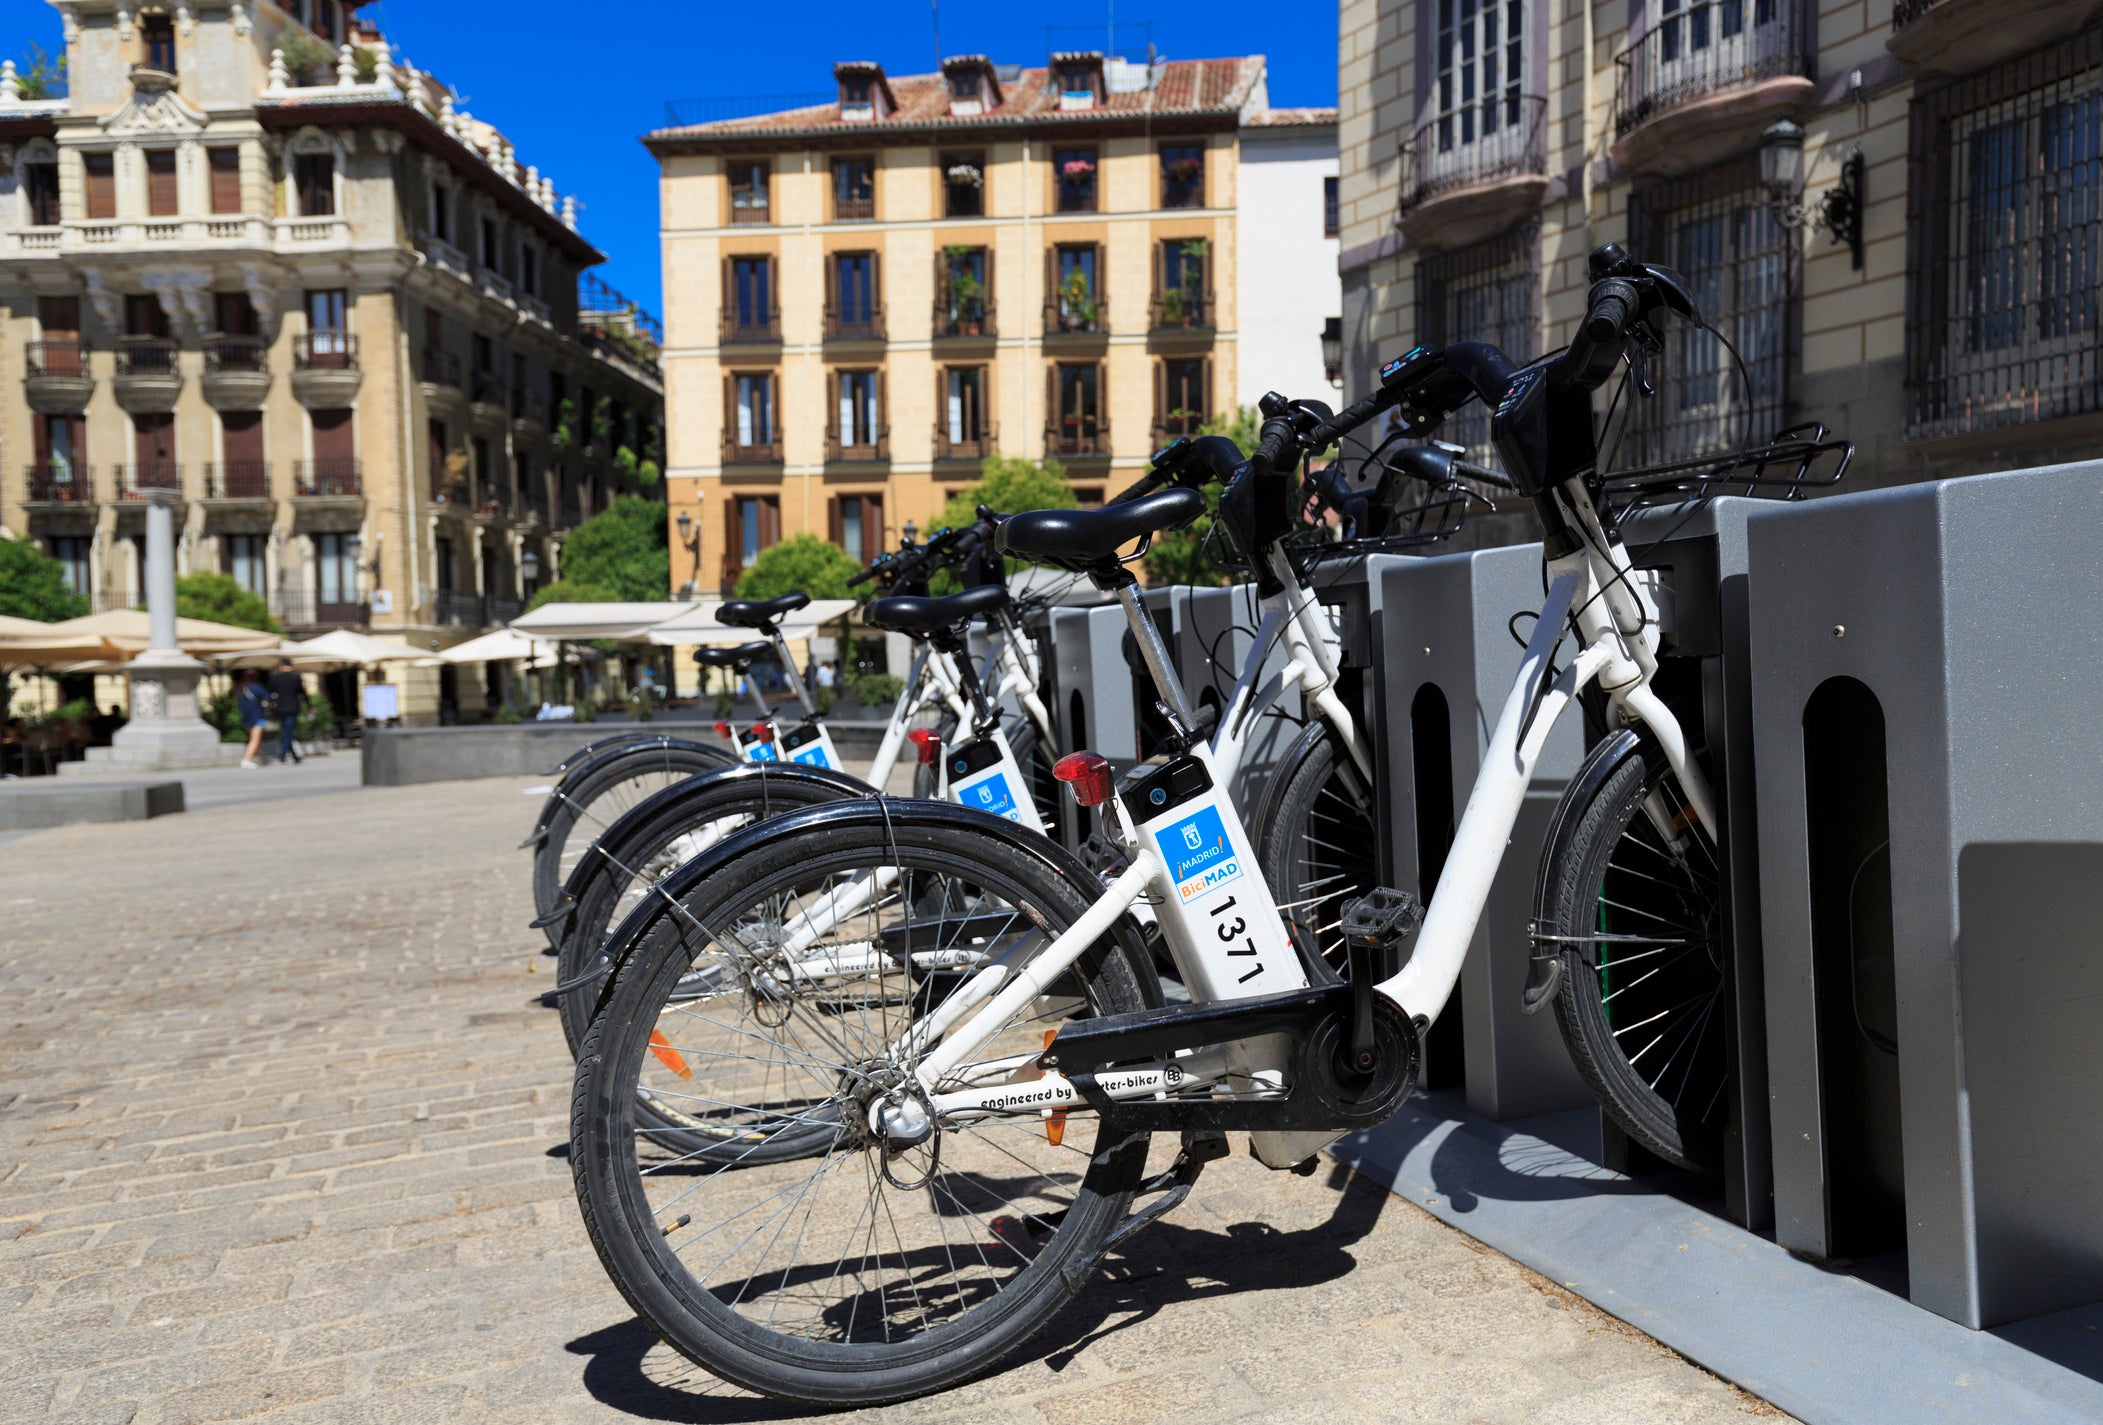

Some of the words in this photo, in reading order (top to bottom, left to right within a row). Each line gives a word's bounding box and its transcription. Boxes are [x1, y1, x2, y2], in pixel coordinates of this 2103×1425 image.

[1176, 835, 1224, 879] ¡MADRID!
[1181, 863, 1238, 898] BiciMAD
[1210, 895, 1265, 984] 1371
[980, 1087, 1052, 1110] engineered
[1056, 1087, 1072, 1100] by
